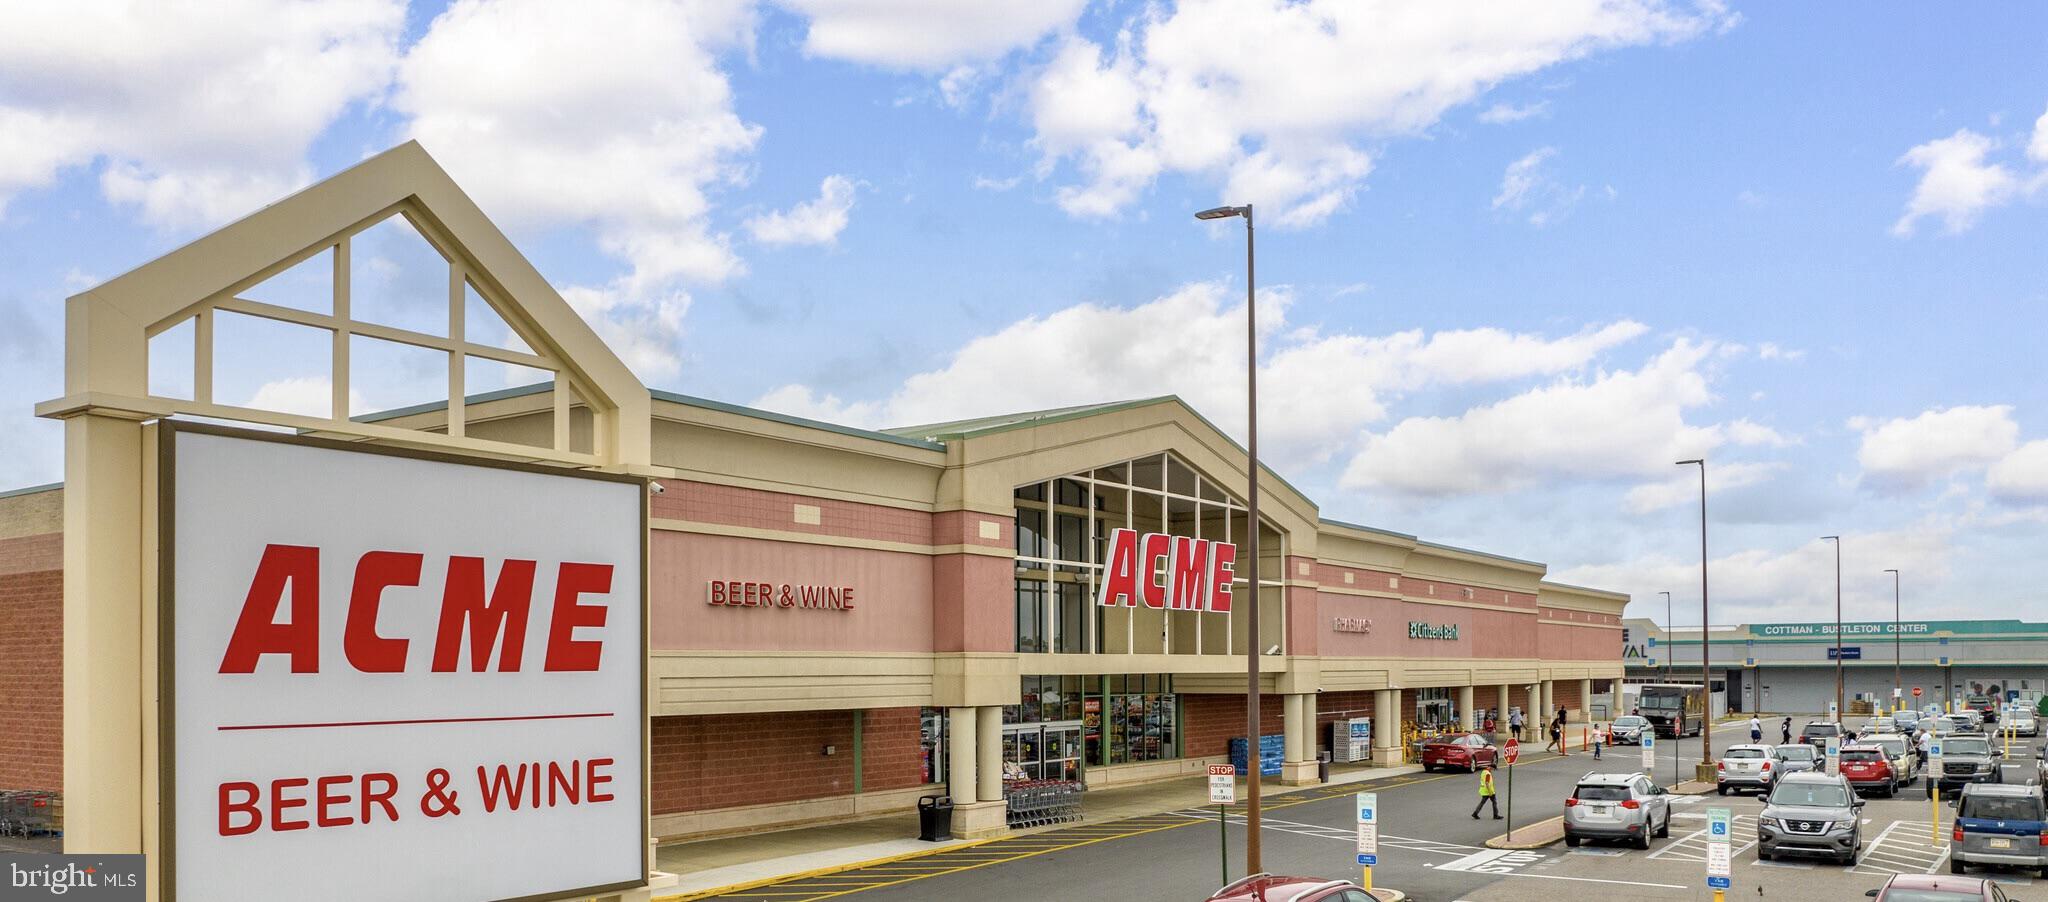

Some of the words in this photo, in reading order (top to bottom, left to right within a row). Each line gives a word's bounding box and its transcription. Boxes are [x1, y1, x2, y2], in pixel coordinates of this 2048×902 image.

[1097, 527, 1237, 613] ACME
[707, 580, 773, 606] BEER
[776, 583, 795, 608] &
[797, 585, 855, 610] WINE
[219, 543, 614, 674] ACME
[1417, 622, 1444, 639] Citizens
[1765, 625, 1813, 635] COTTMAN
[1886, 623, 1928, 633] CENTER
[1504, 745, 1518, 757] STOP
[1210, 766, 1233, 774] STOP
[218, 773, 399, 837] BEER
[420, 768, 461, 818] &
[476, 757, 615, 813] WINE
[1470, 850, 1547, 873] STOP
